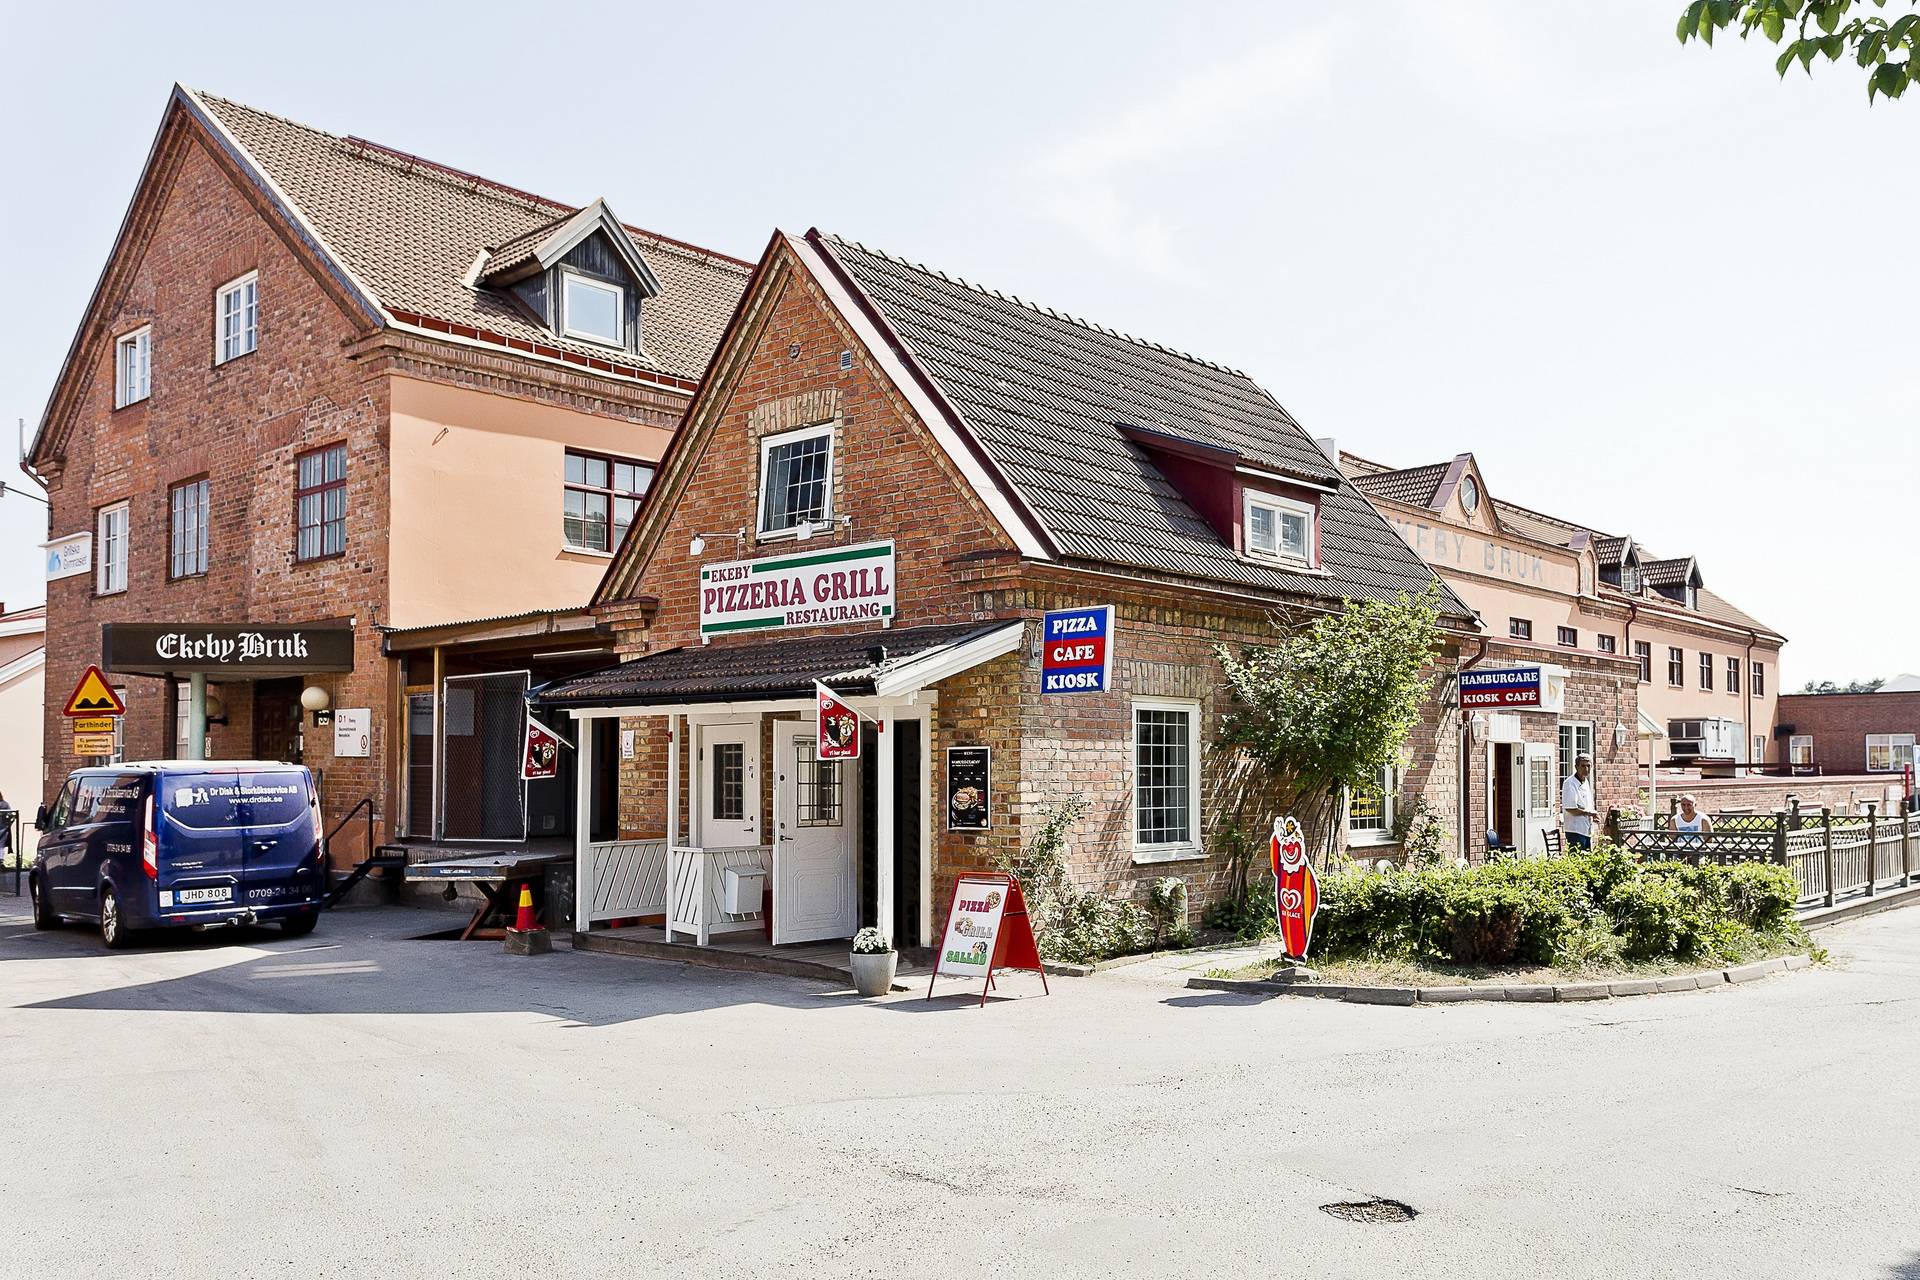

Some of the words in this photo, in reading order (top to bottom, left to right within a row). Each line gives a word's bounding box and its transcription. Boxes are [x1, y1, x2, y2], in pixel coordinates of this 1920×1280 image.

[1383, 515, 1465, 563] KEBY
[1484, 543, 1543, 582] BRUK
[711, 566, 750, 582] EKEBY
[704, 578, 806, 614] PIZZERIA
[813, 567, 889, 602] GRILL
[786, 602, 880, 625] RESTAURANG
[1052, 616, 1097, 634] PIZZA
[155, 633, 235, 663] Ekeby
[238, 632, 309, 662] Bruk
[1053, 645, 1095, 662] CAFE
[1046, 673, 1099, 690] KIOSK
[1461, 672, 1538, 685] HAMBURGARE
[1463, 693, 1500, 703] KIOSK
[1505, 690, 1537, 701] CAFÉ
[210, 787, 219, 796] Dr
[219, 786, 234, 796] Disk
[234, 786, 240, 797] &
[288, 786, 298, 794] AB
[228, 796, 283, 804] www.drdisk.se
[184, 890, 205, 900] JHD
[207, 888, 228, 898] 808
[249, 888, 286, 898] 0709-24
[289, 886, 299, 895] 34
[958, 899, 991, 913] PIZZA
[1287, 911, 1301, 919] GLACE
[961, 925, 993, 939] GRILL
[945, 950, 988, 966] SALLAD
